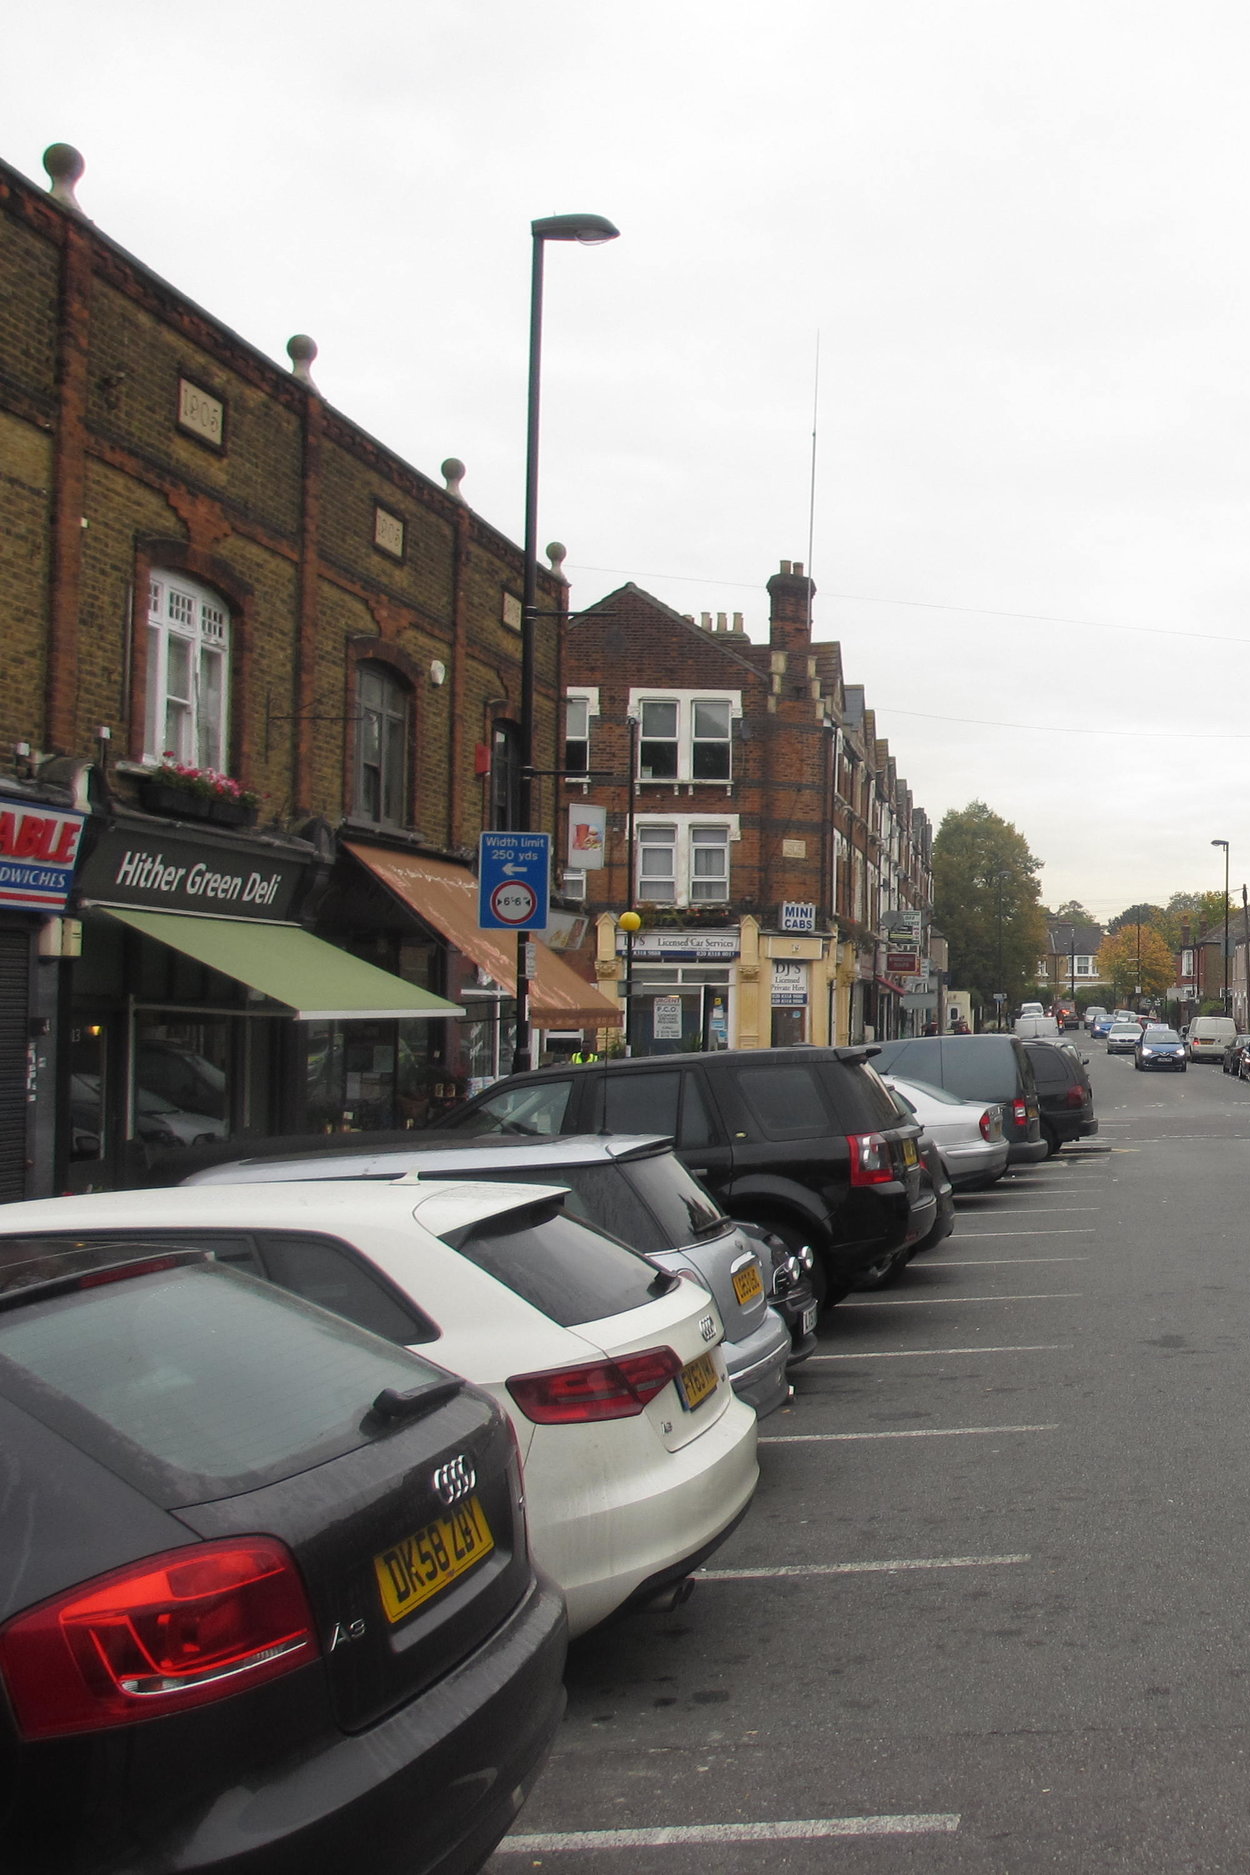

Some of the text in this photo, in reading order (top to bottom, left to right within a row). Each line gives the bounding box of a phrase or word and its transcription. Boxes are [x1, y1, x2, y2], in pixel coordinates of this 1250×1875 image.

[485, 837, 518, 847] Width
[492, 850, 538, 862] 250 yds
[116, 851, 282, 905] Hither Green Deli
[785, 906, 813, 918] MINI
[784, 919, 813, 929] CABS
[657, 937, 689, 947] Licensed
[690, 938, 704, 947] Car
[706, 938, 734, 948] Services
[383, 1524, 450, 1603] DK58
[329, 1617, 366, 1653] A3
